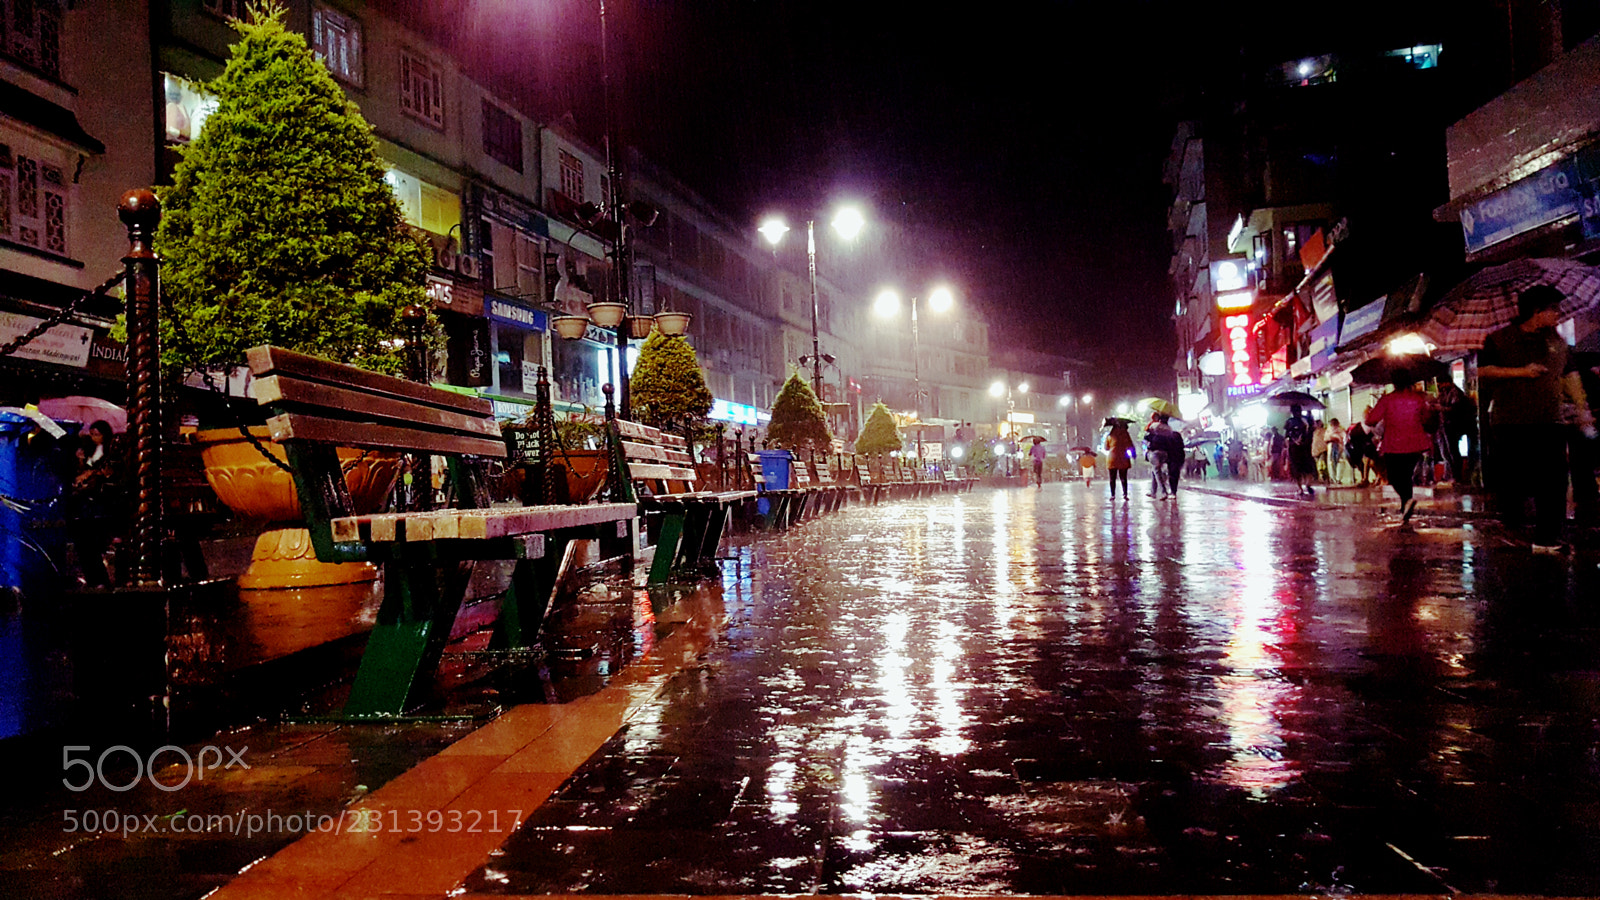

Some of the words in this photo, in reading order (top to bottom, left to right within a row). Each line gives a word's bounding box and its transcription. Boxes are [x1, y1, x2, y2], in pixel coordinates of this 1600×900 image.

[426, 283, 453, 304] ANS
[490, 300, 534, 325] SAMSUNG
[91, 342, 126, 362] INDIA
[1225, 314, 1253, 386] MASALA
[515, 431, 525, 440] Do
